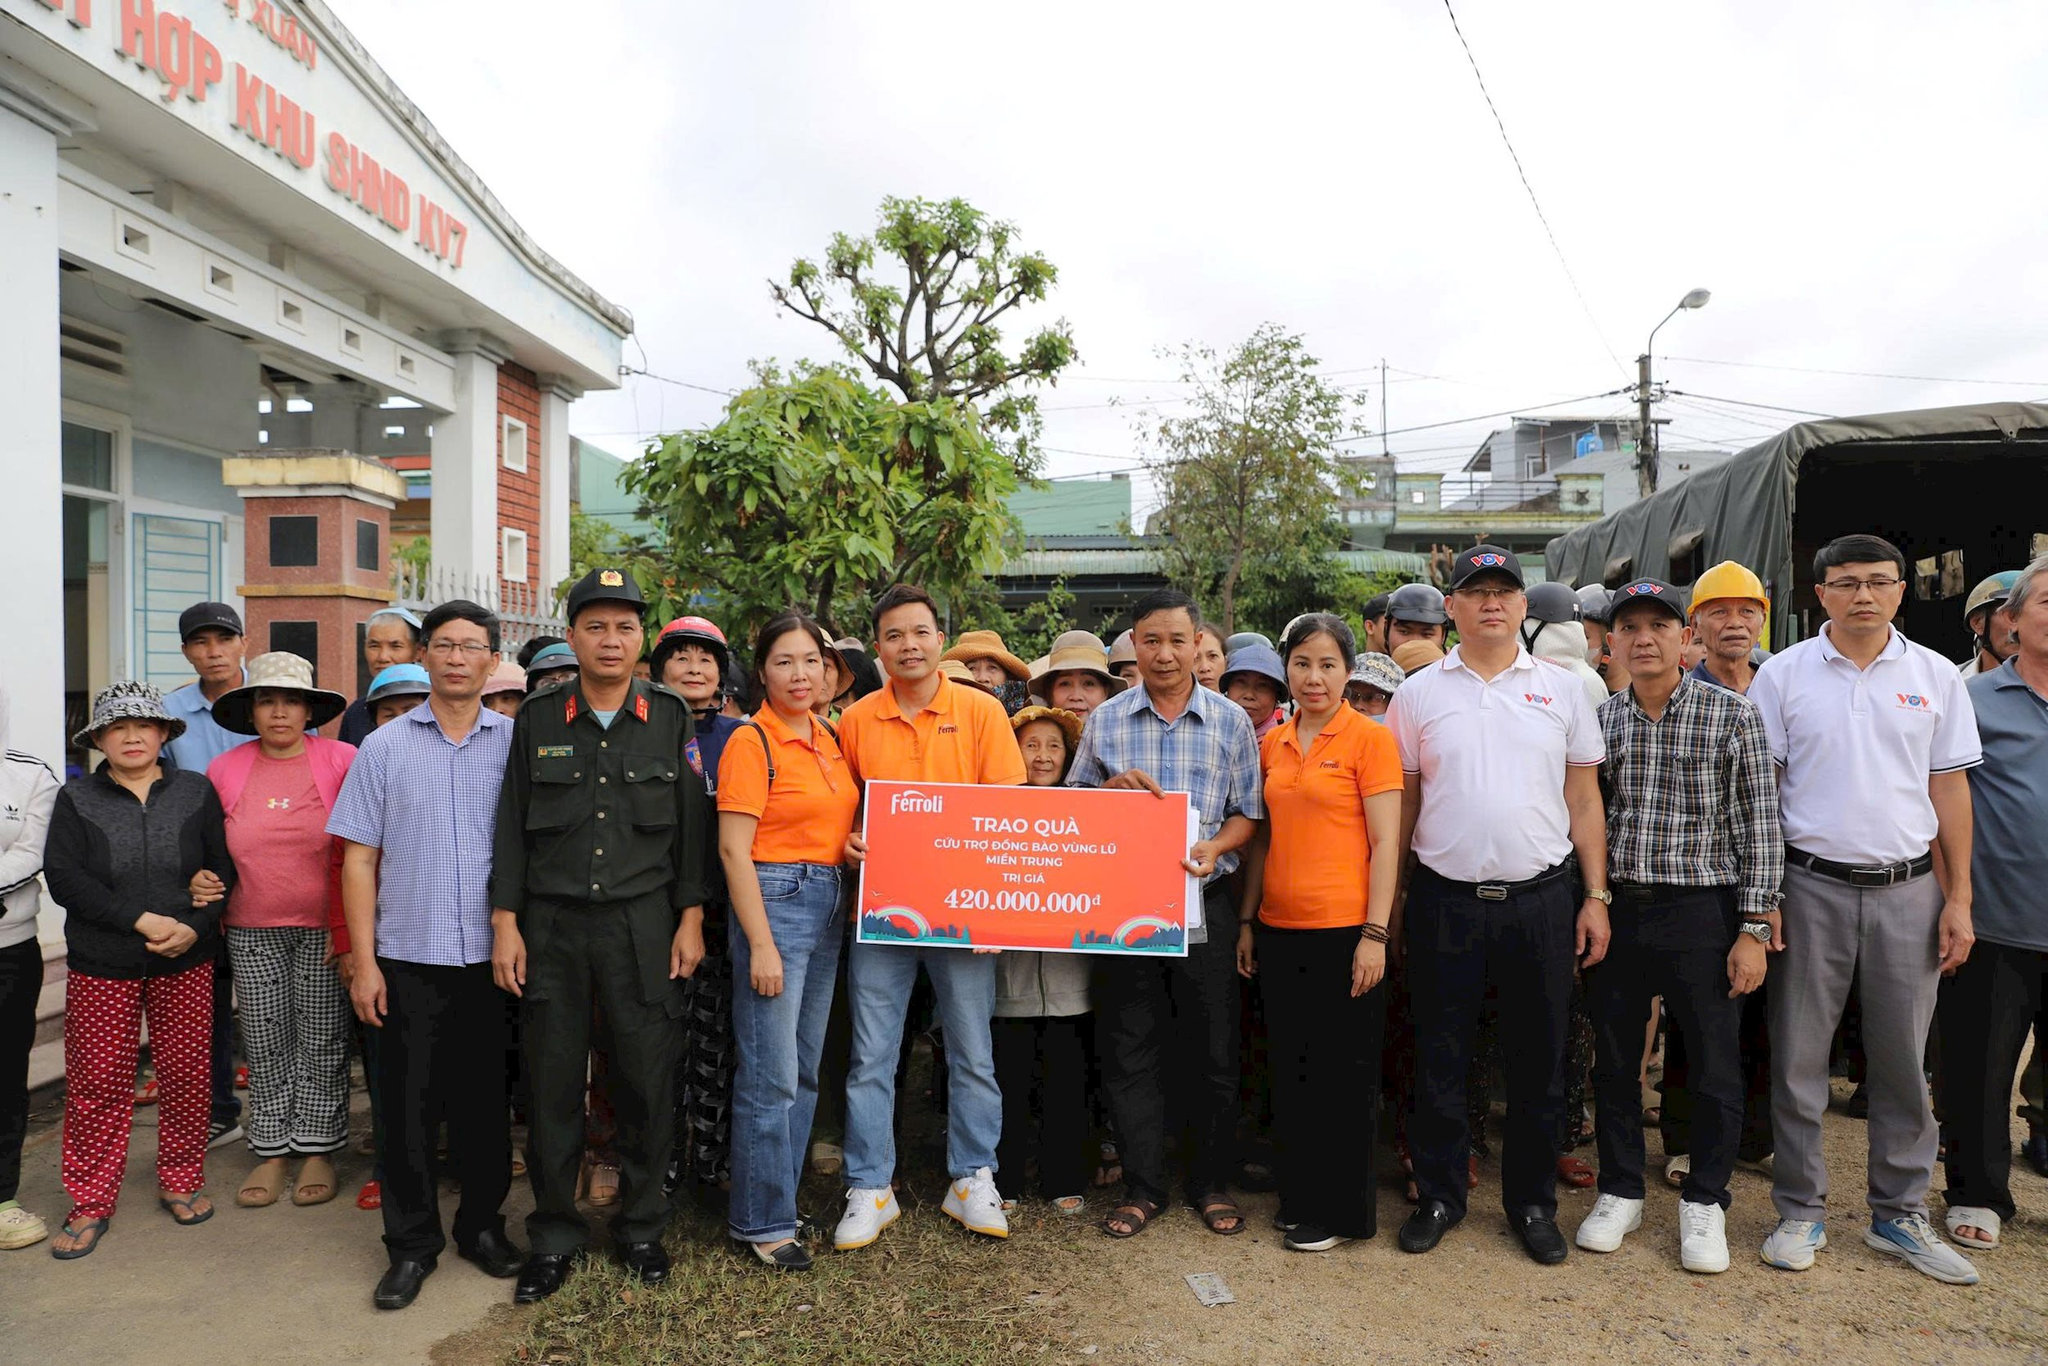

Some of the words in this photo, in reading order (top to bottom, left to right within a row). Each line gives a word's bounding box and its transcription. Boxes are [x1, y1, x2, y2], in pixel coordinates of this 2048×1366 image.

[236, 62, 315, 169] KHU
[328, 132, 410, 231] SHND
[419, 194, 467, 268] KV7
[1470, 553, 1506, 567] VOV
[1626, 583, 1663, 596] VOV
[1524, 693, 1552, 706] VOV
[1896, 693, 1929, 708] VOV
[891, 790, 943, 815] Ferroli
[972, 816, 1029, 834] TRAO
[1034, 817, 1080, 837] QUÀ
[934, 837, 960, 849] CỨU
[963, 839, 989, 852] TRỢ
[1032, 840, 1059, 853] BÀO
[1062, 841, 1098, 854] VÙNG
[1101, 843, 1117, 855] LŨ
[1020, 856, 1063, 867] TRUNG
[1002, 872, 1021, 885] TRỊ
[1024, 872, 1045, 884] GIÁ
